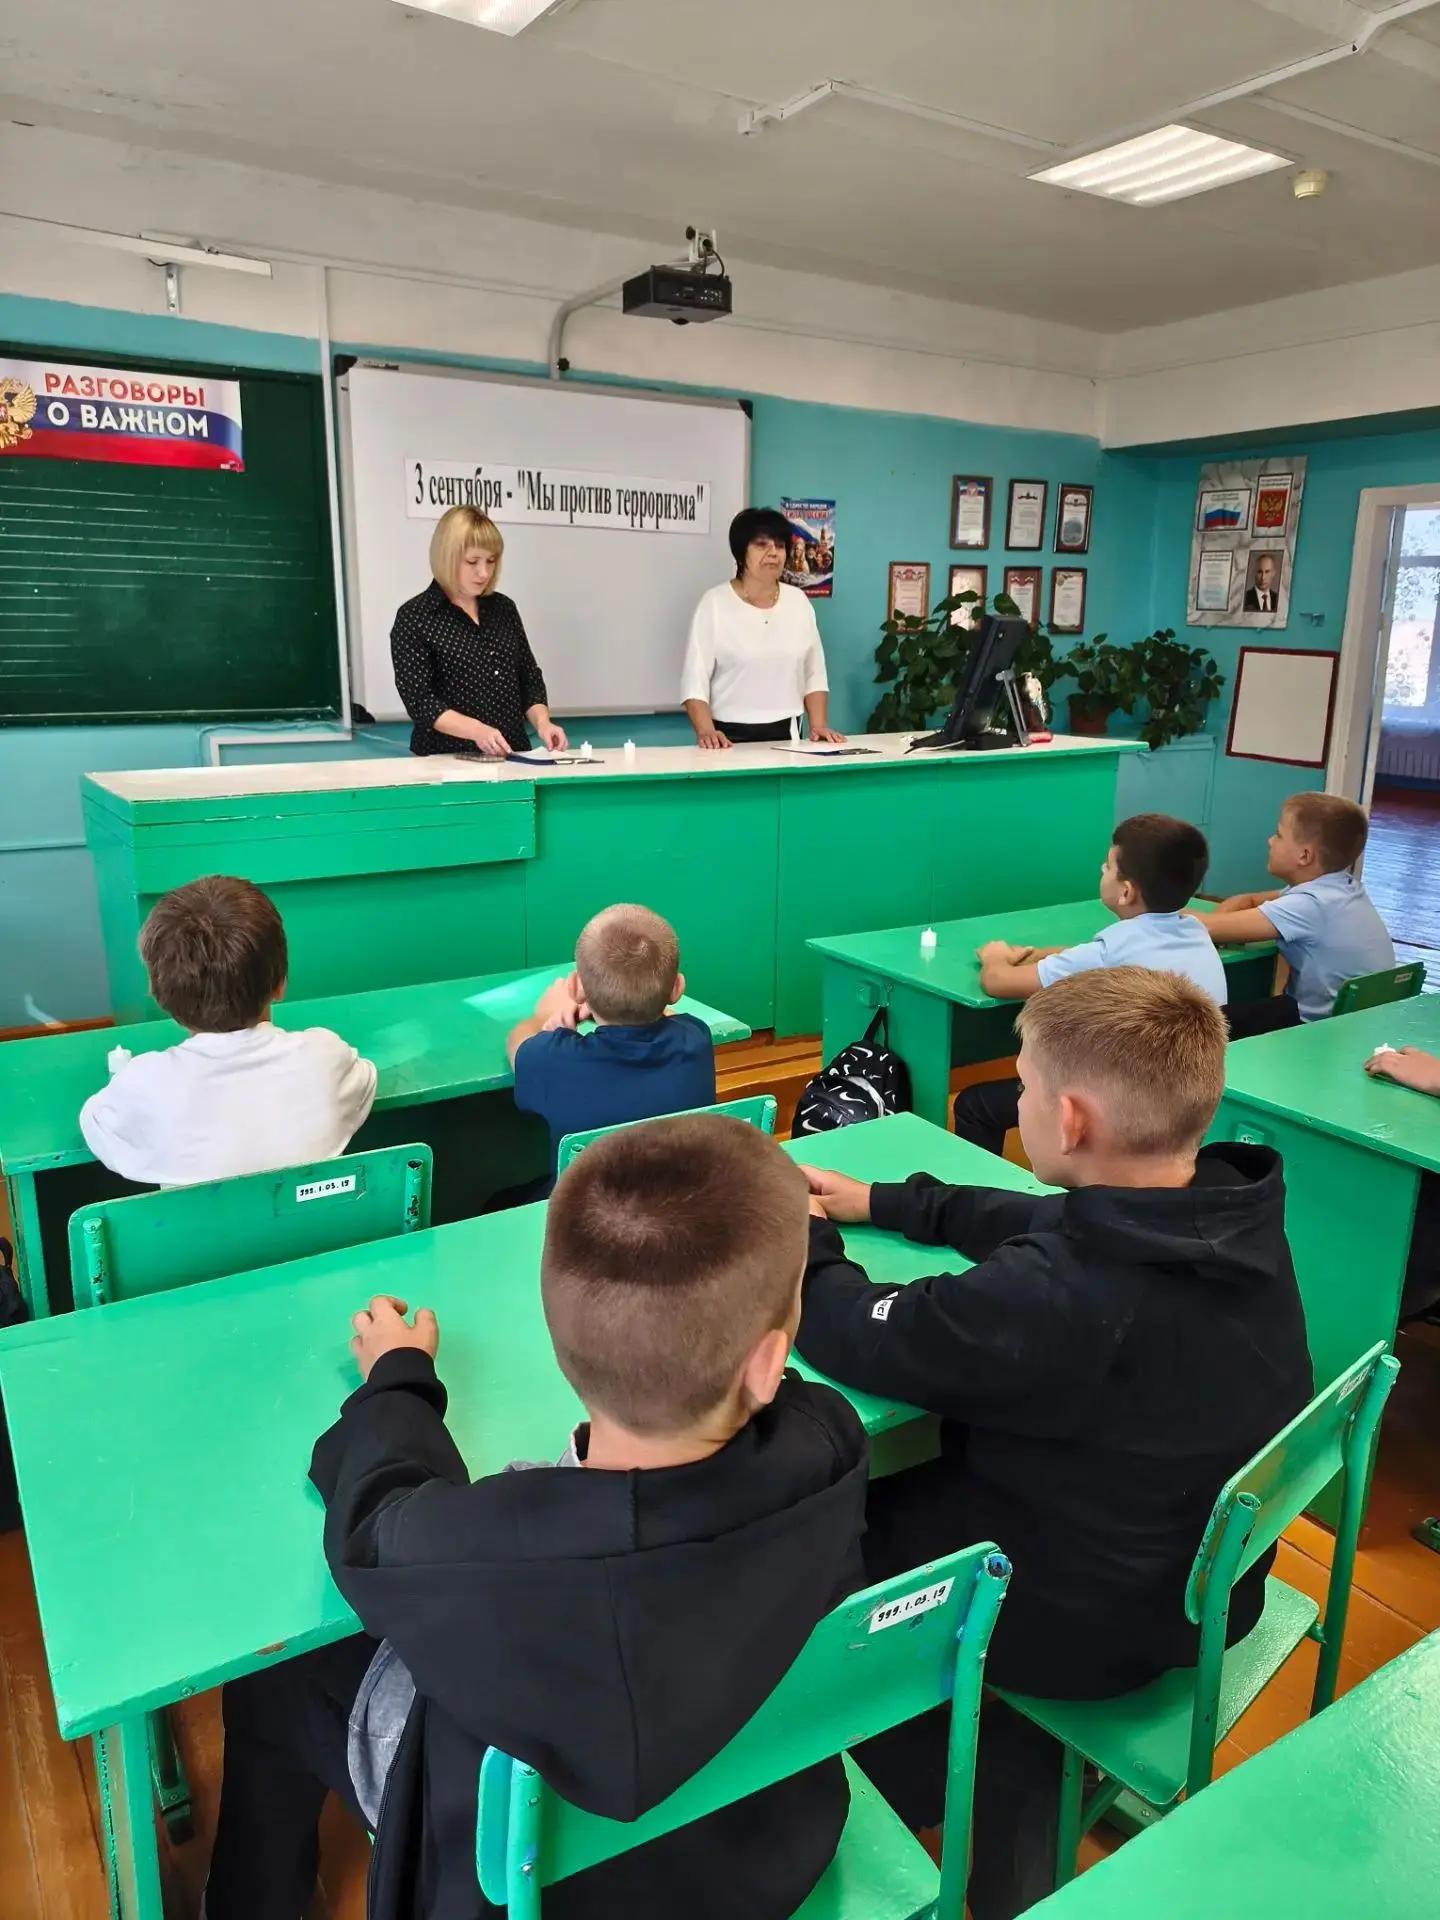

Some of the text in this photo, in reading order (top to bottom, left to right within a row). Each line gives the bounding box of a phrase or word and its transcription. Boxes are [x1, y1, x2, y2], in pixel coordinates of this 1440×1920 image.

[44, 372, 205, 407] РАЗГОВОРЫ
[47, 401, 209, 438] О ВАЖНОМ
[415, 462, 424, 504] 3
[429, 467, 503, 515] сентября
[517, 470, 555, 511] "Мы
[560, 484, 612, 524] против
[616, 485, 704, 529] терроризма"
